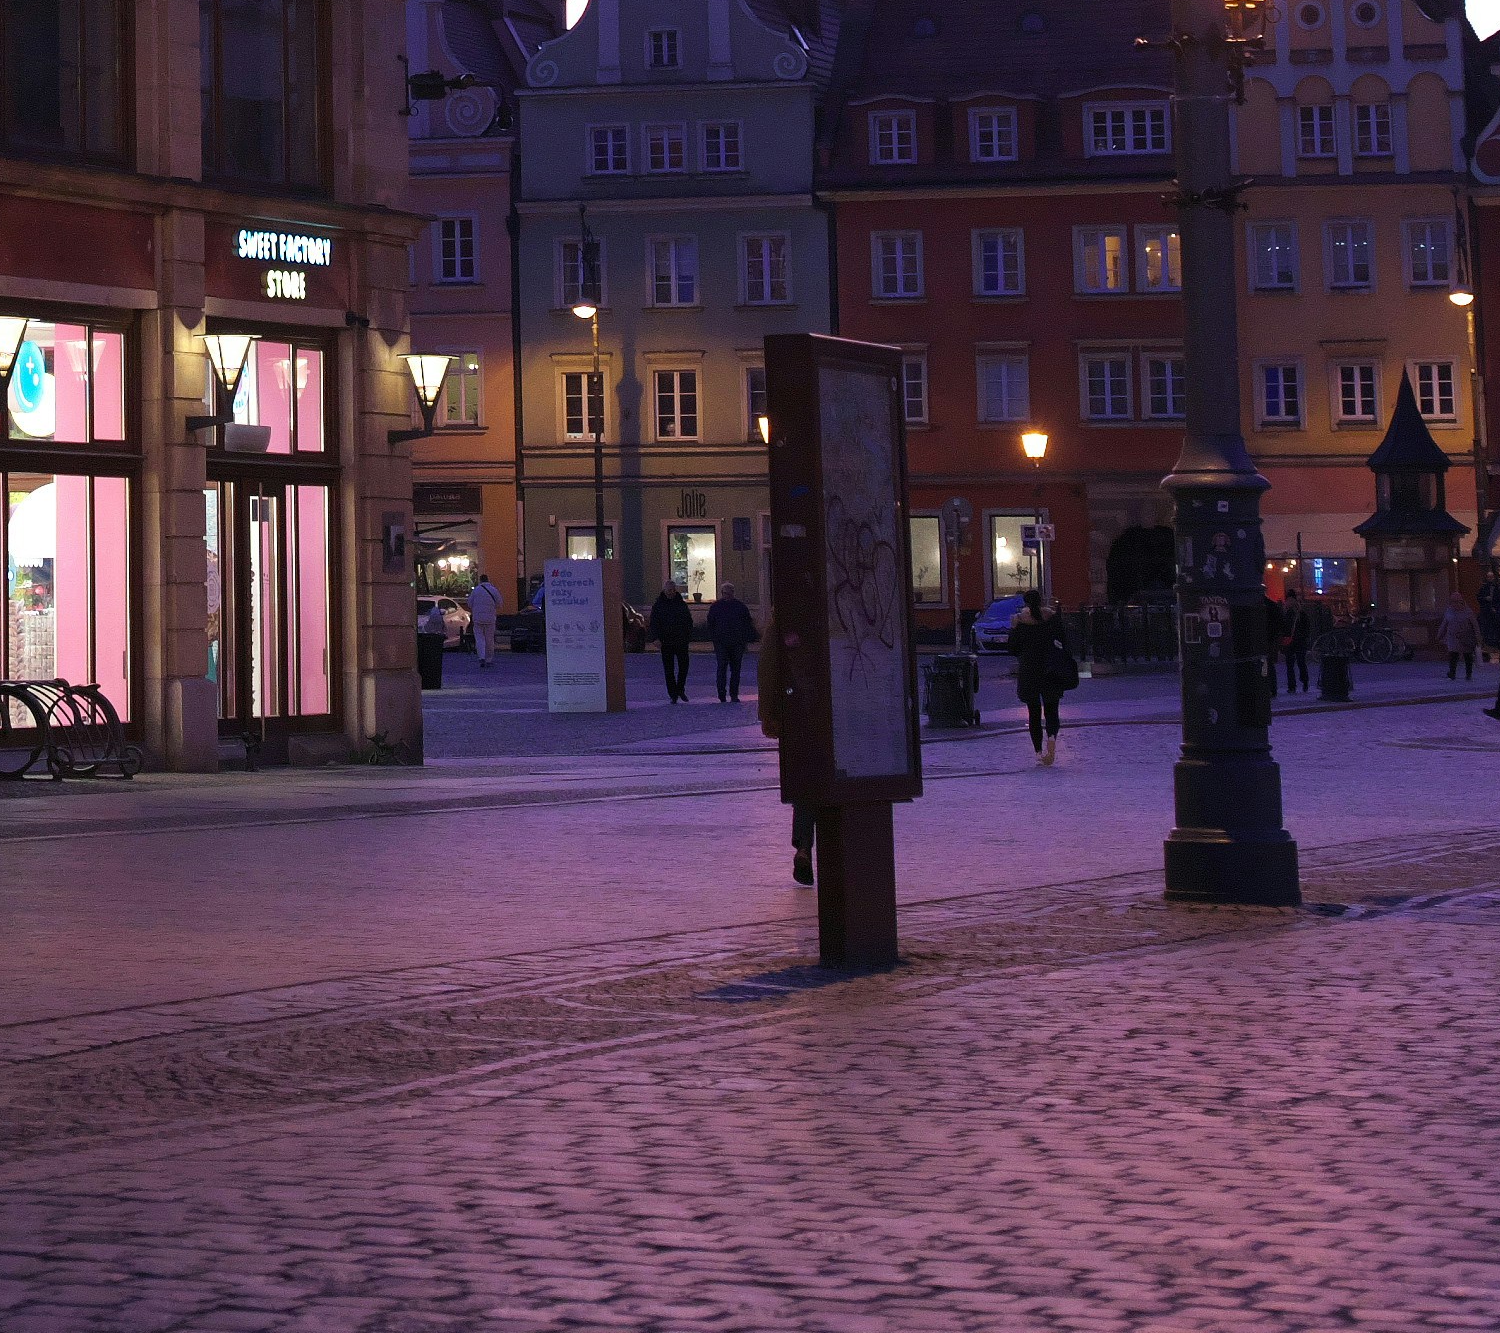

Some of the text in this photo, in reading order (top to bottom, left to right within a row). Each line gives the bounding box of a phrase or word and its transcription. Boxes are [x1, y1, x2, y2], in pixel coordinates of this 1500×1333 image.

[238, 229, 332, 267] SWEET FACTORY
[266, 269, 306, 300] STORE
